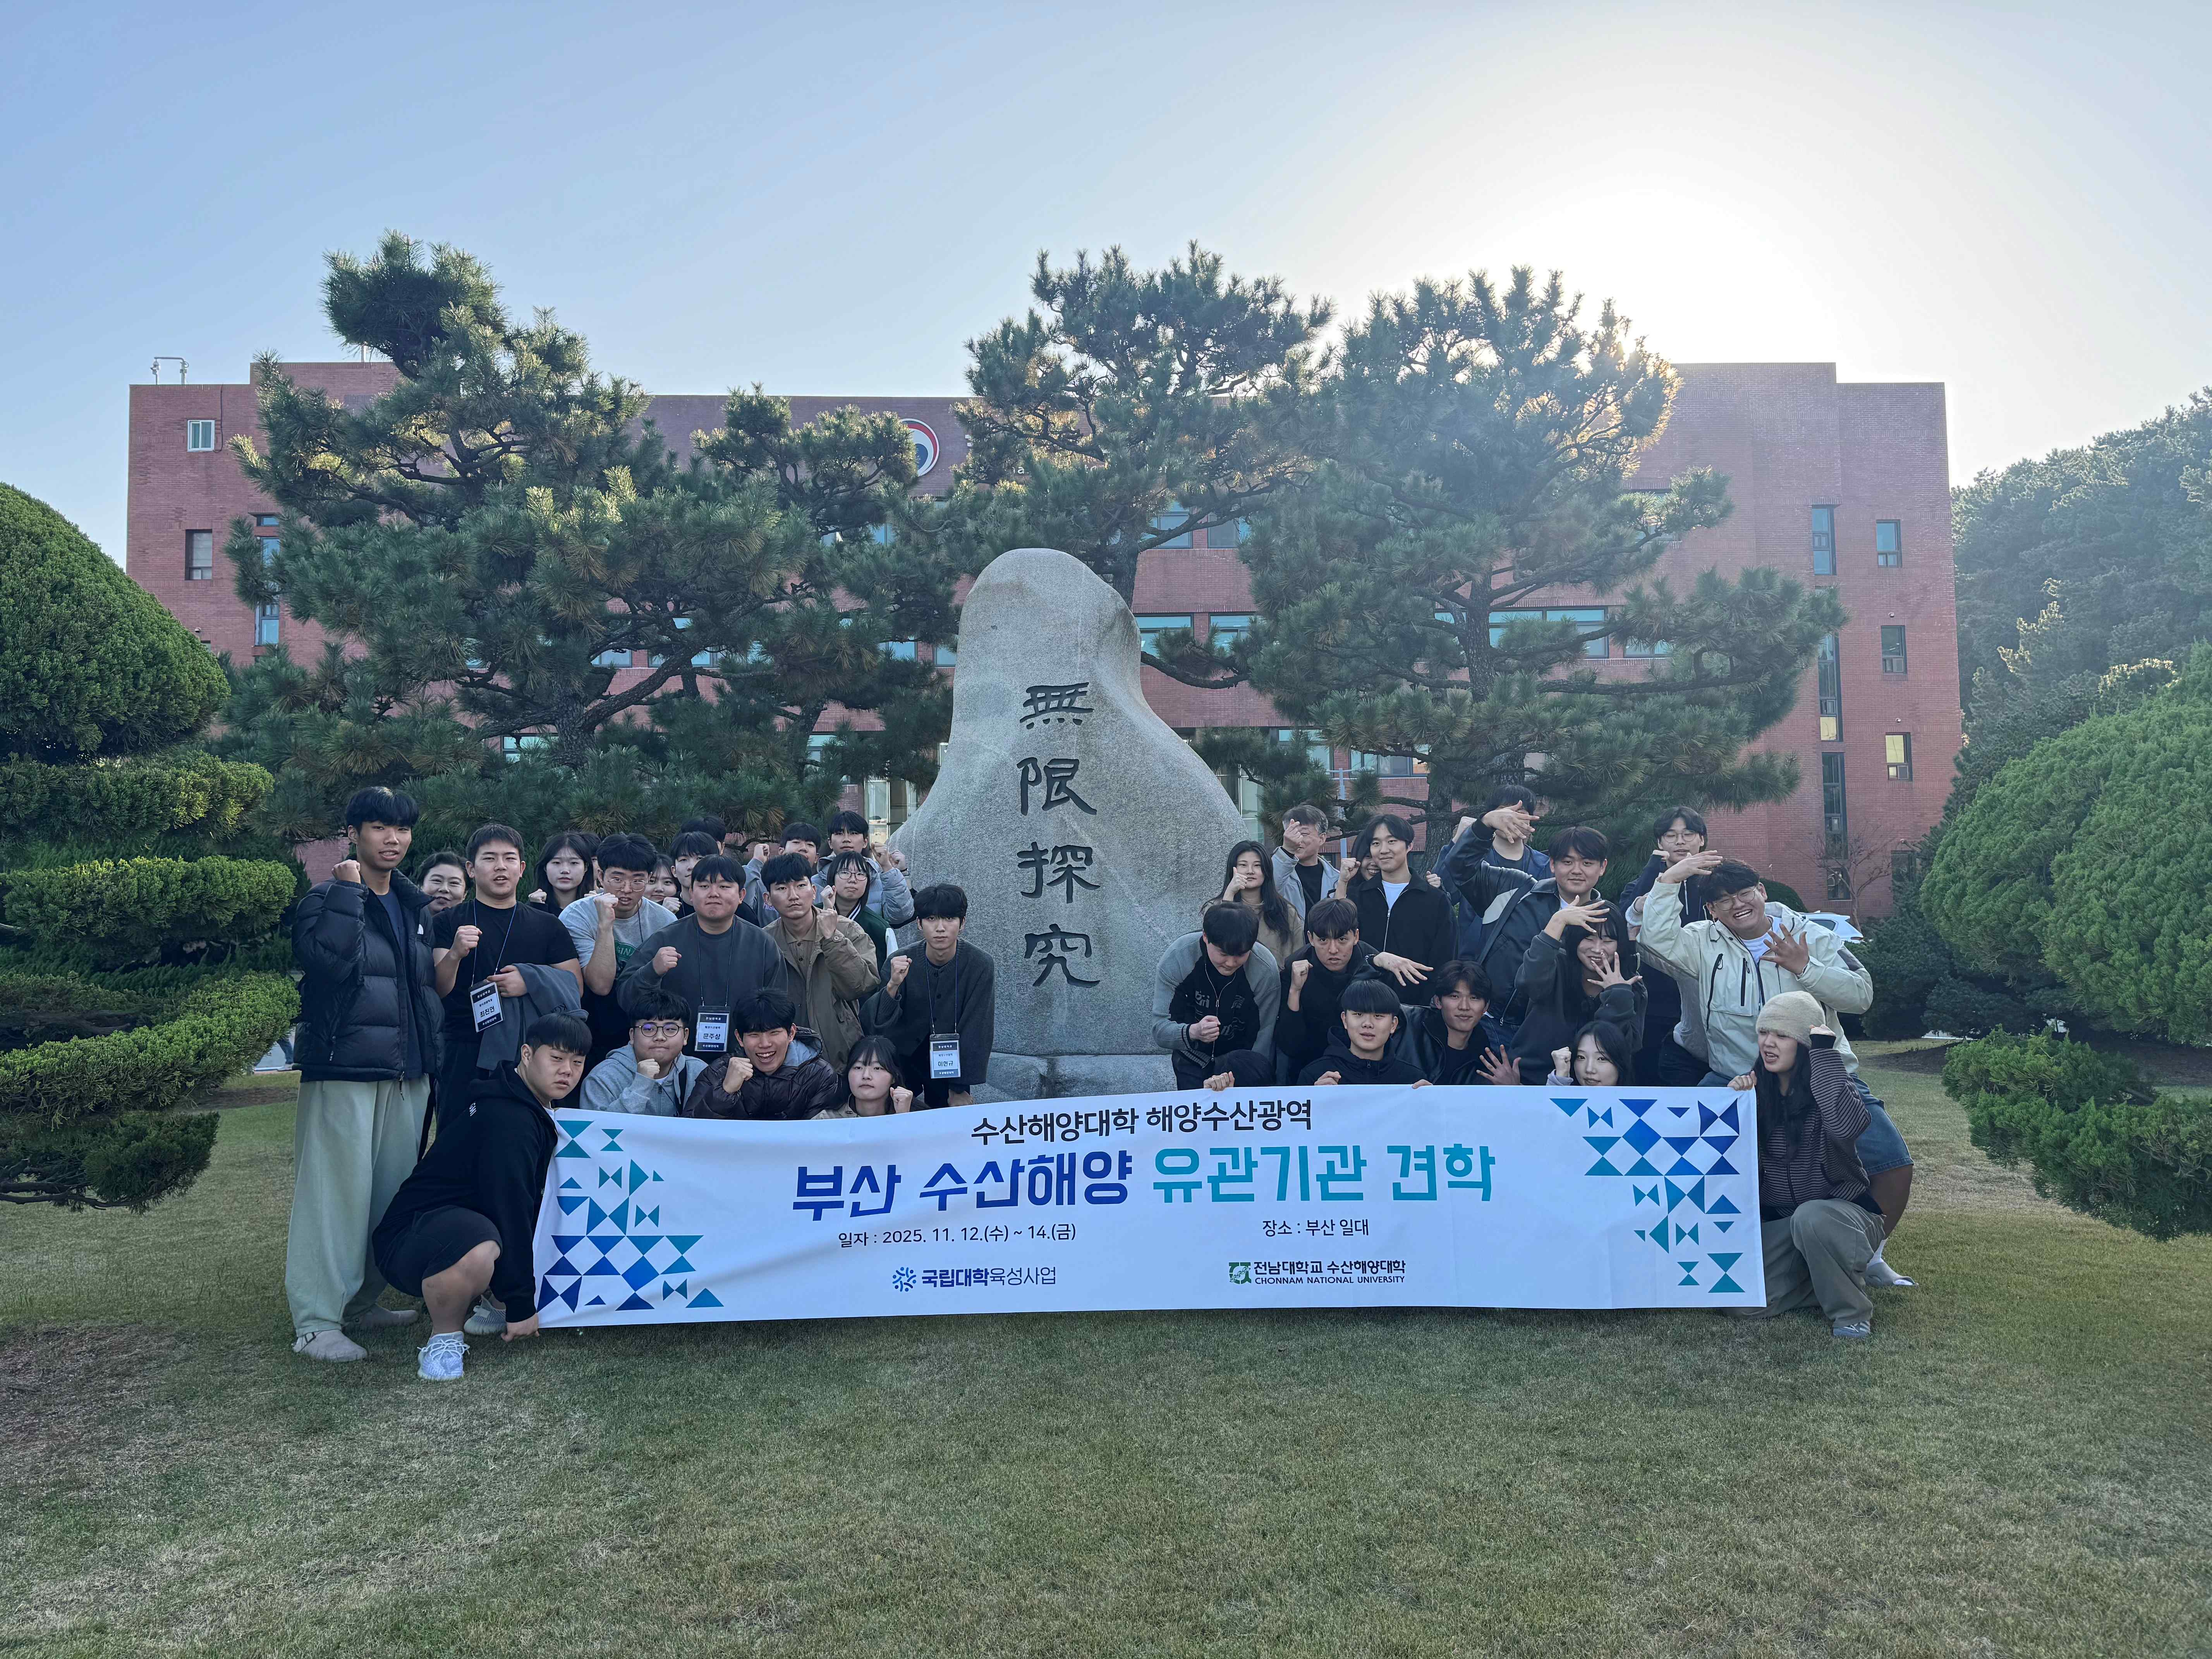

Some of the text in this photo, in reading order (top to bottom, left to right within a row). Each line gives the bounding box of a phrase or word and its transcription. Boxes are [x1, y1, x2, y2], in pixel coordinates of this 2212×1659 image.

[971, 1099, 1311, 1146] 수산해양대학 해양수산광역
[793, 1143, 1496, 1221] 부산 수산해양 유관기관 견학
[838, 1232, 869, 1248] 일자
[883, 1229, 926, 1243] 2025.
[933, 1228, 954, 1242] 11.
[1262, 1219, 1292, 1237] 장소
[1305, 1219, 1336, 1236] 부산
[1340, 1219, 1369, 1236] 일대
[922, 1267, 1056, 1288] 국립대학육성사업
[1254, 1260, 1406, 1275] 전남대학교 수산해양대학
